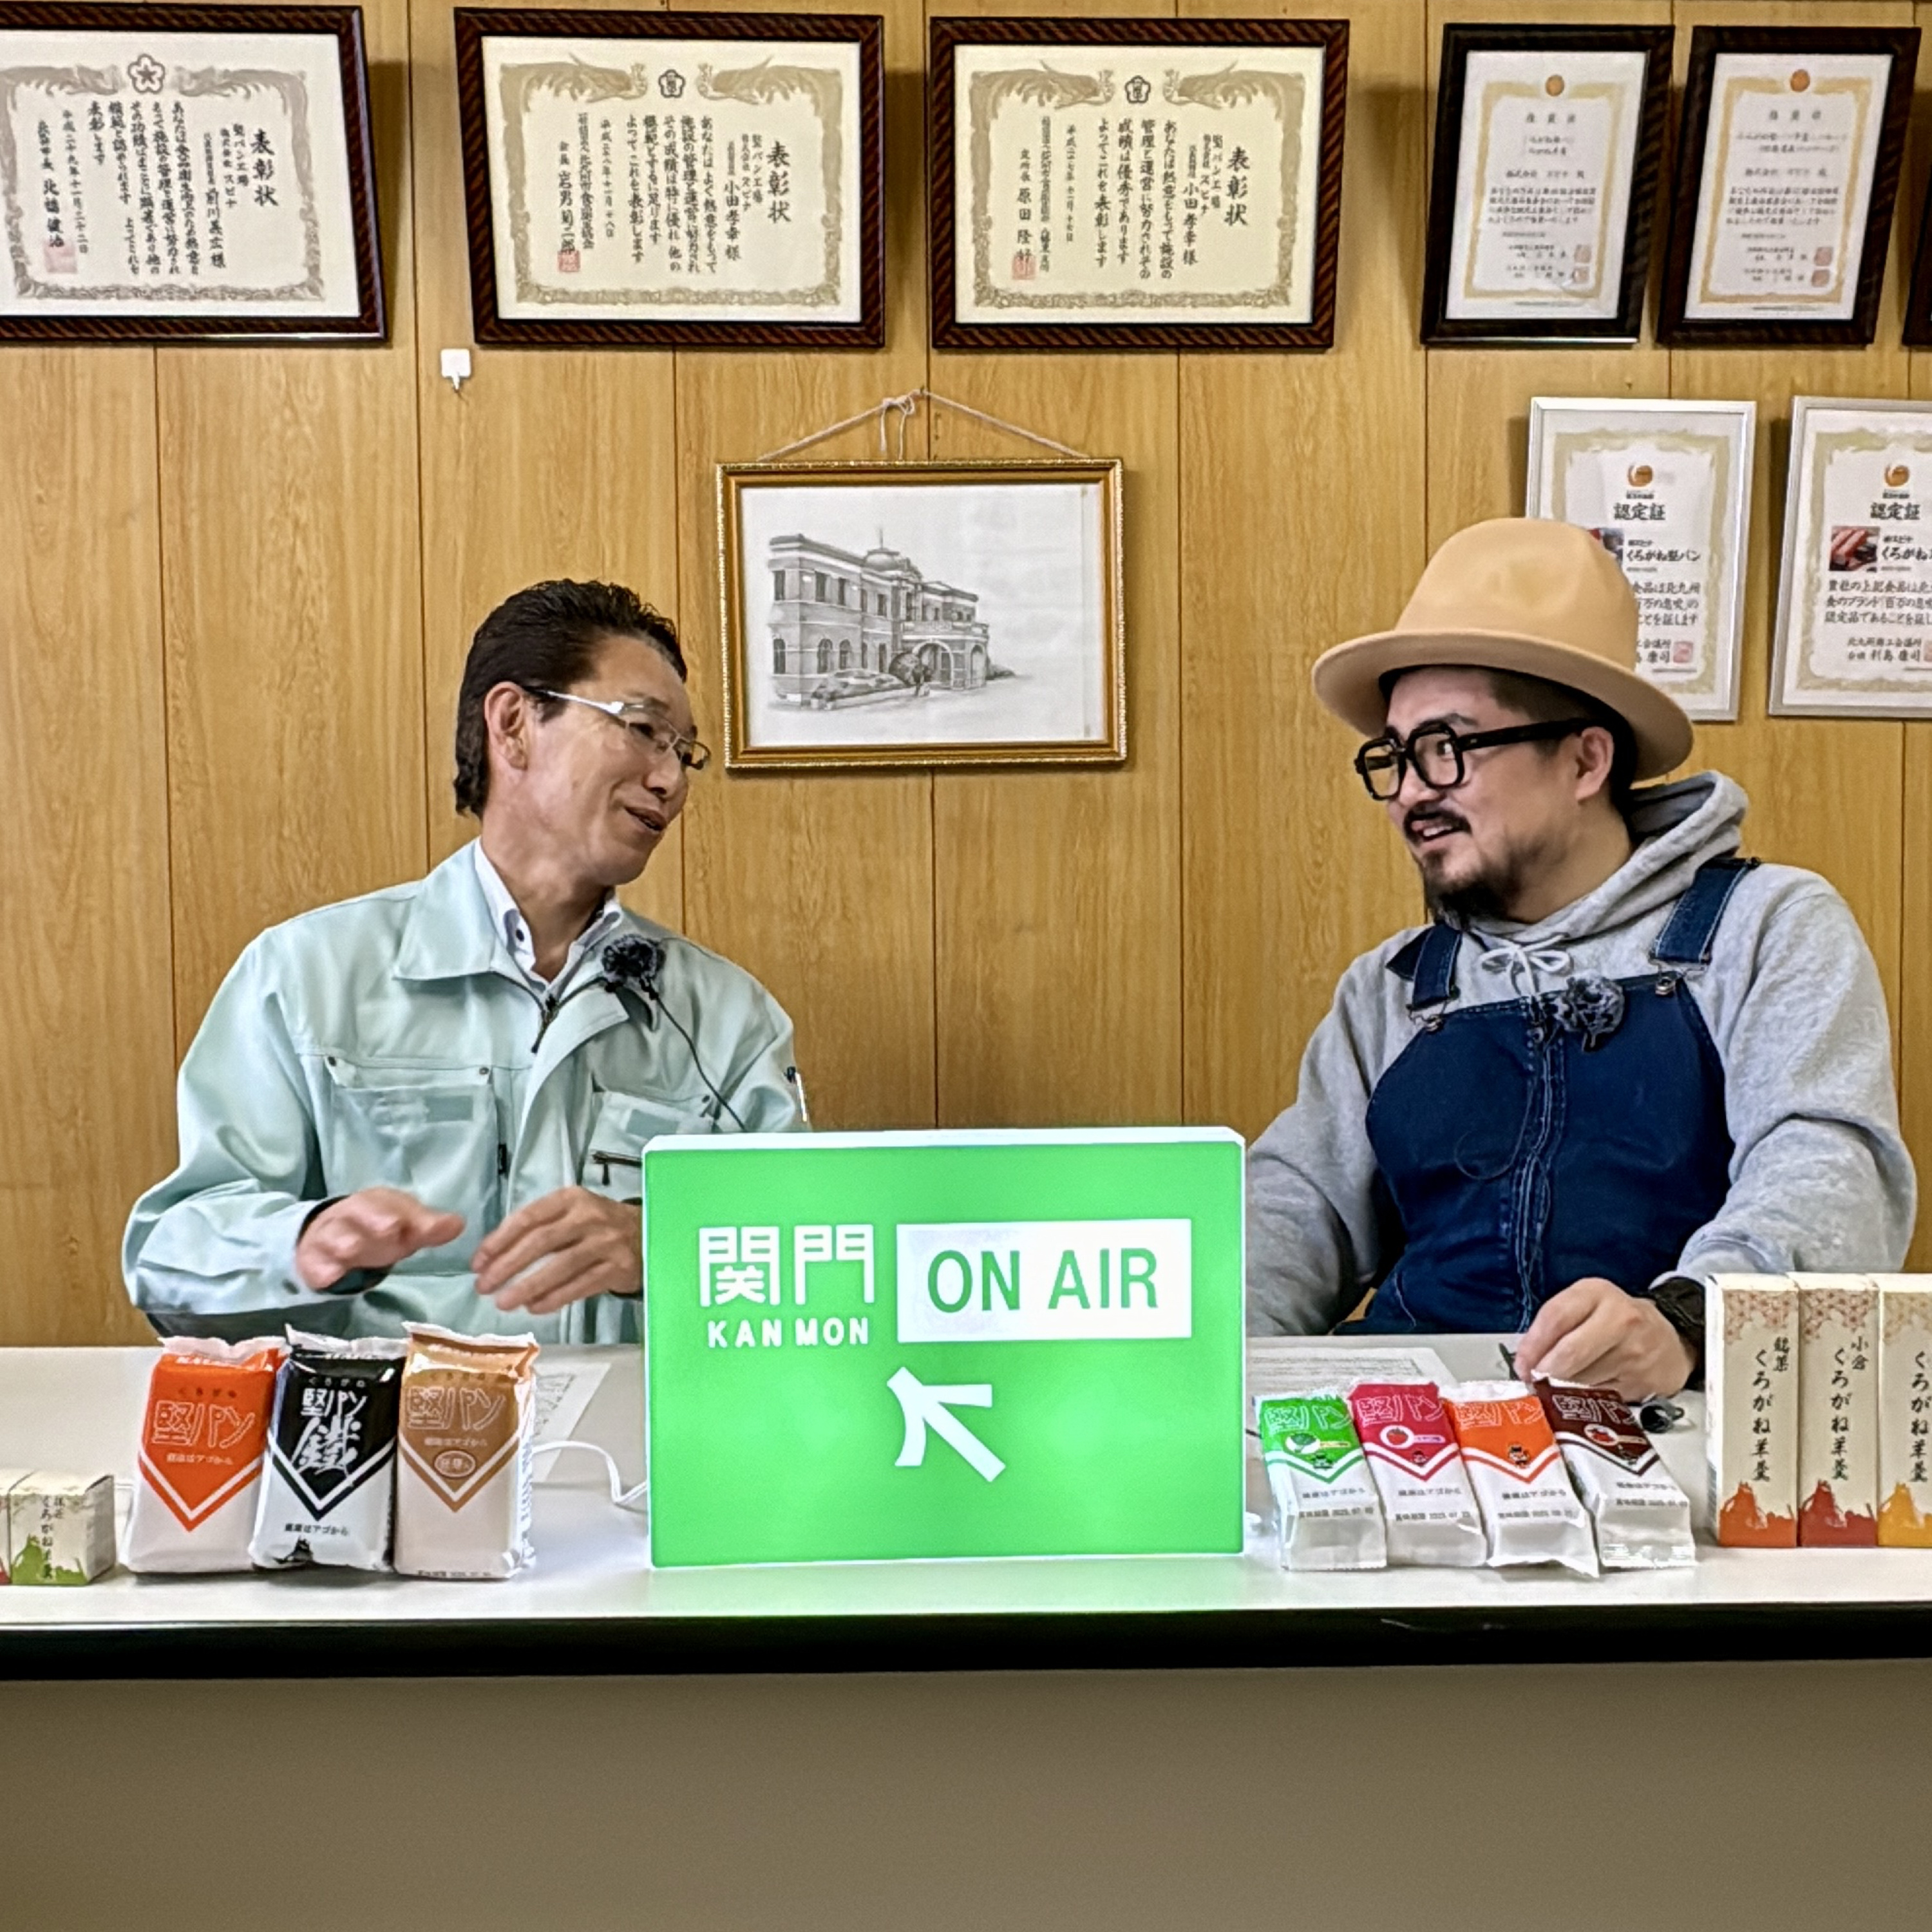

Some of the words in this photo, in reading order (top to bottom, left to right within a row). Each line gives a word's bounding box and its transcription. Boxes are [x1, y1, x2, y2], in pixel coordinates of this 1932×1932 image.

[250, 128, 278, 207] 表彰状
[766, 140, 791, 224] 表彰状
[1224, 146, 1250, 227] 表彰状
[1613, 502, 1666, 521] 認定証
[1870, 502, 1921, 520] 認定証
[698, 1224, 875, 1308] 関門
[927, 1249, 1020, 1314] ON
[1048, 1247, 1159, 1311] AIR
[1851, 1336, 1869, 1370] 小倉
[151, 1400, 256, 1448] 堅パン
[300, 1388, 368, 1417] 堅パン
[407, 1386, 506, 1431] 堅パン
[1265, 1404, 1352, 1435] 堅パン
[1356, 1394, 1443, 1428] 堅パン
[1454, 1401, 1545, 1430] 堅パン
[1552, 1394, 1636, 1426] 堅パン
[1751, 1349, 1774, 1482] くろがね羊羹
[1831, 1347, 1853, 1481] くろがね羊羹
[1909, 1351, 1932, 1482] くろがね羊羹
